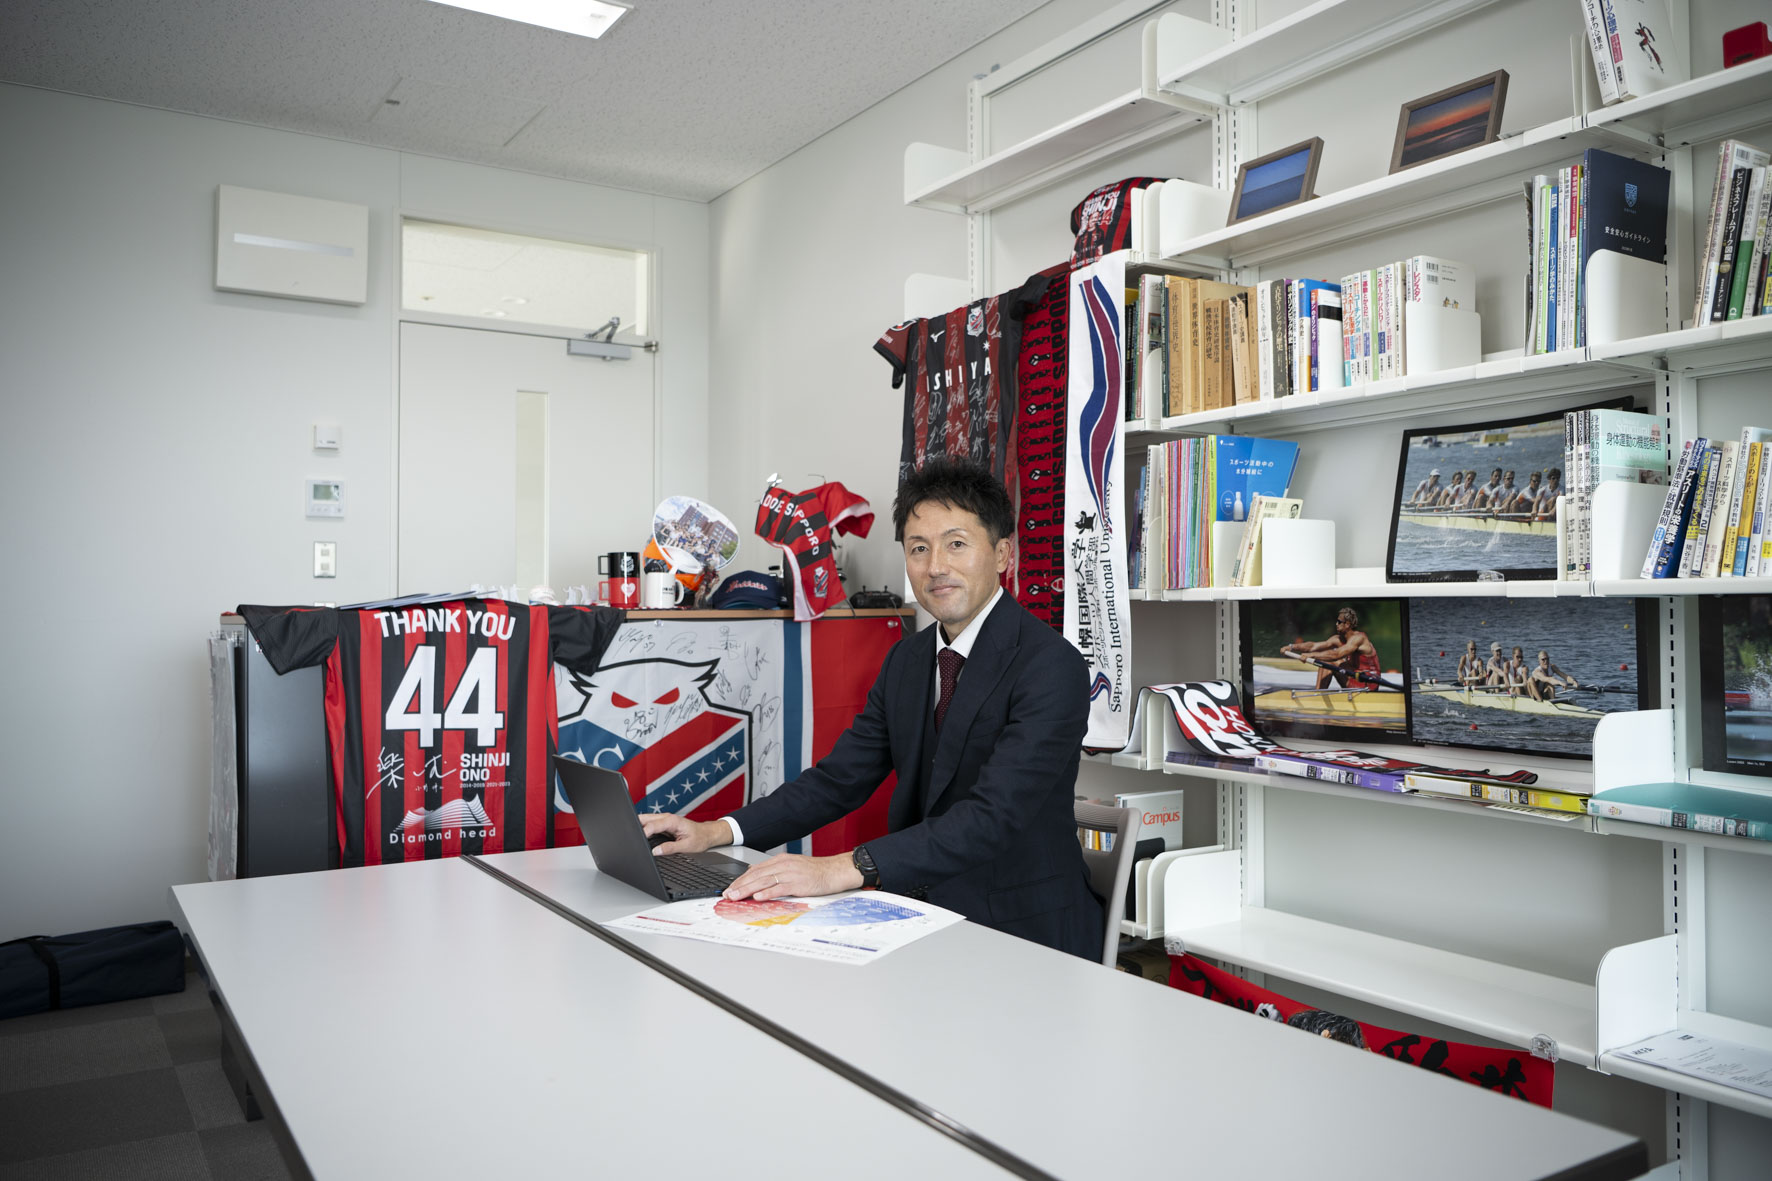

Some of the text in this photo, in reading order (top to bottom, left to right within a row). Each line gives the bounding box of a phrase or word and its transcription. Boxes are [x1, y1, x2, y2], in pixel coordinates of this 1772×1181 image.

[1724, 171, 1744, 260] ビジネスフレームワーク図鑑
[1605, 226, 1651, 243] 安全安心ガイドライン
[926, 356, 992, 393] ISHIYA
[1606, 431, 1662, 451] 身体運動の機能解剖
[1229, 458, 1275, 468] スポーツ活動中の
[1235, 468, 1263, 476] 水分補給に
[1746, 445, 1759, 495] スポーツのちから
[1659, 450, 1690, 527] 労働基準法と就業規則
[1719, 456, 1733, 506] スポーツ科学から
[1664, 469, 1696, 546] アスリートの栄養学
[1071, 537, 1096, 669] 札幌国際大学
[1099, 480, 1124, 714] Sapporo International University
[374, 609, 516, 641] THANK YOU
[385, 645, 504, 748] 44
[460, 752, 511, 767] SHINJI
[460, 768, 491, 781] ONO
[389, 826, 496, 845] Diamond head
[1142, 810, 1181, 827] Campus
